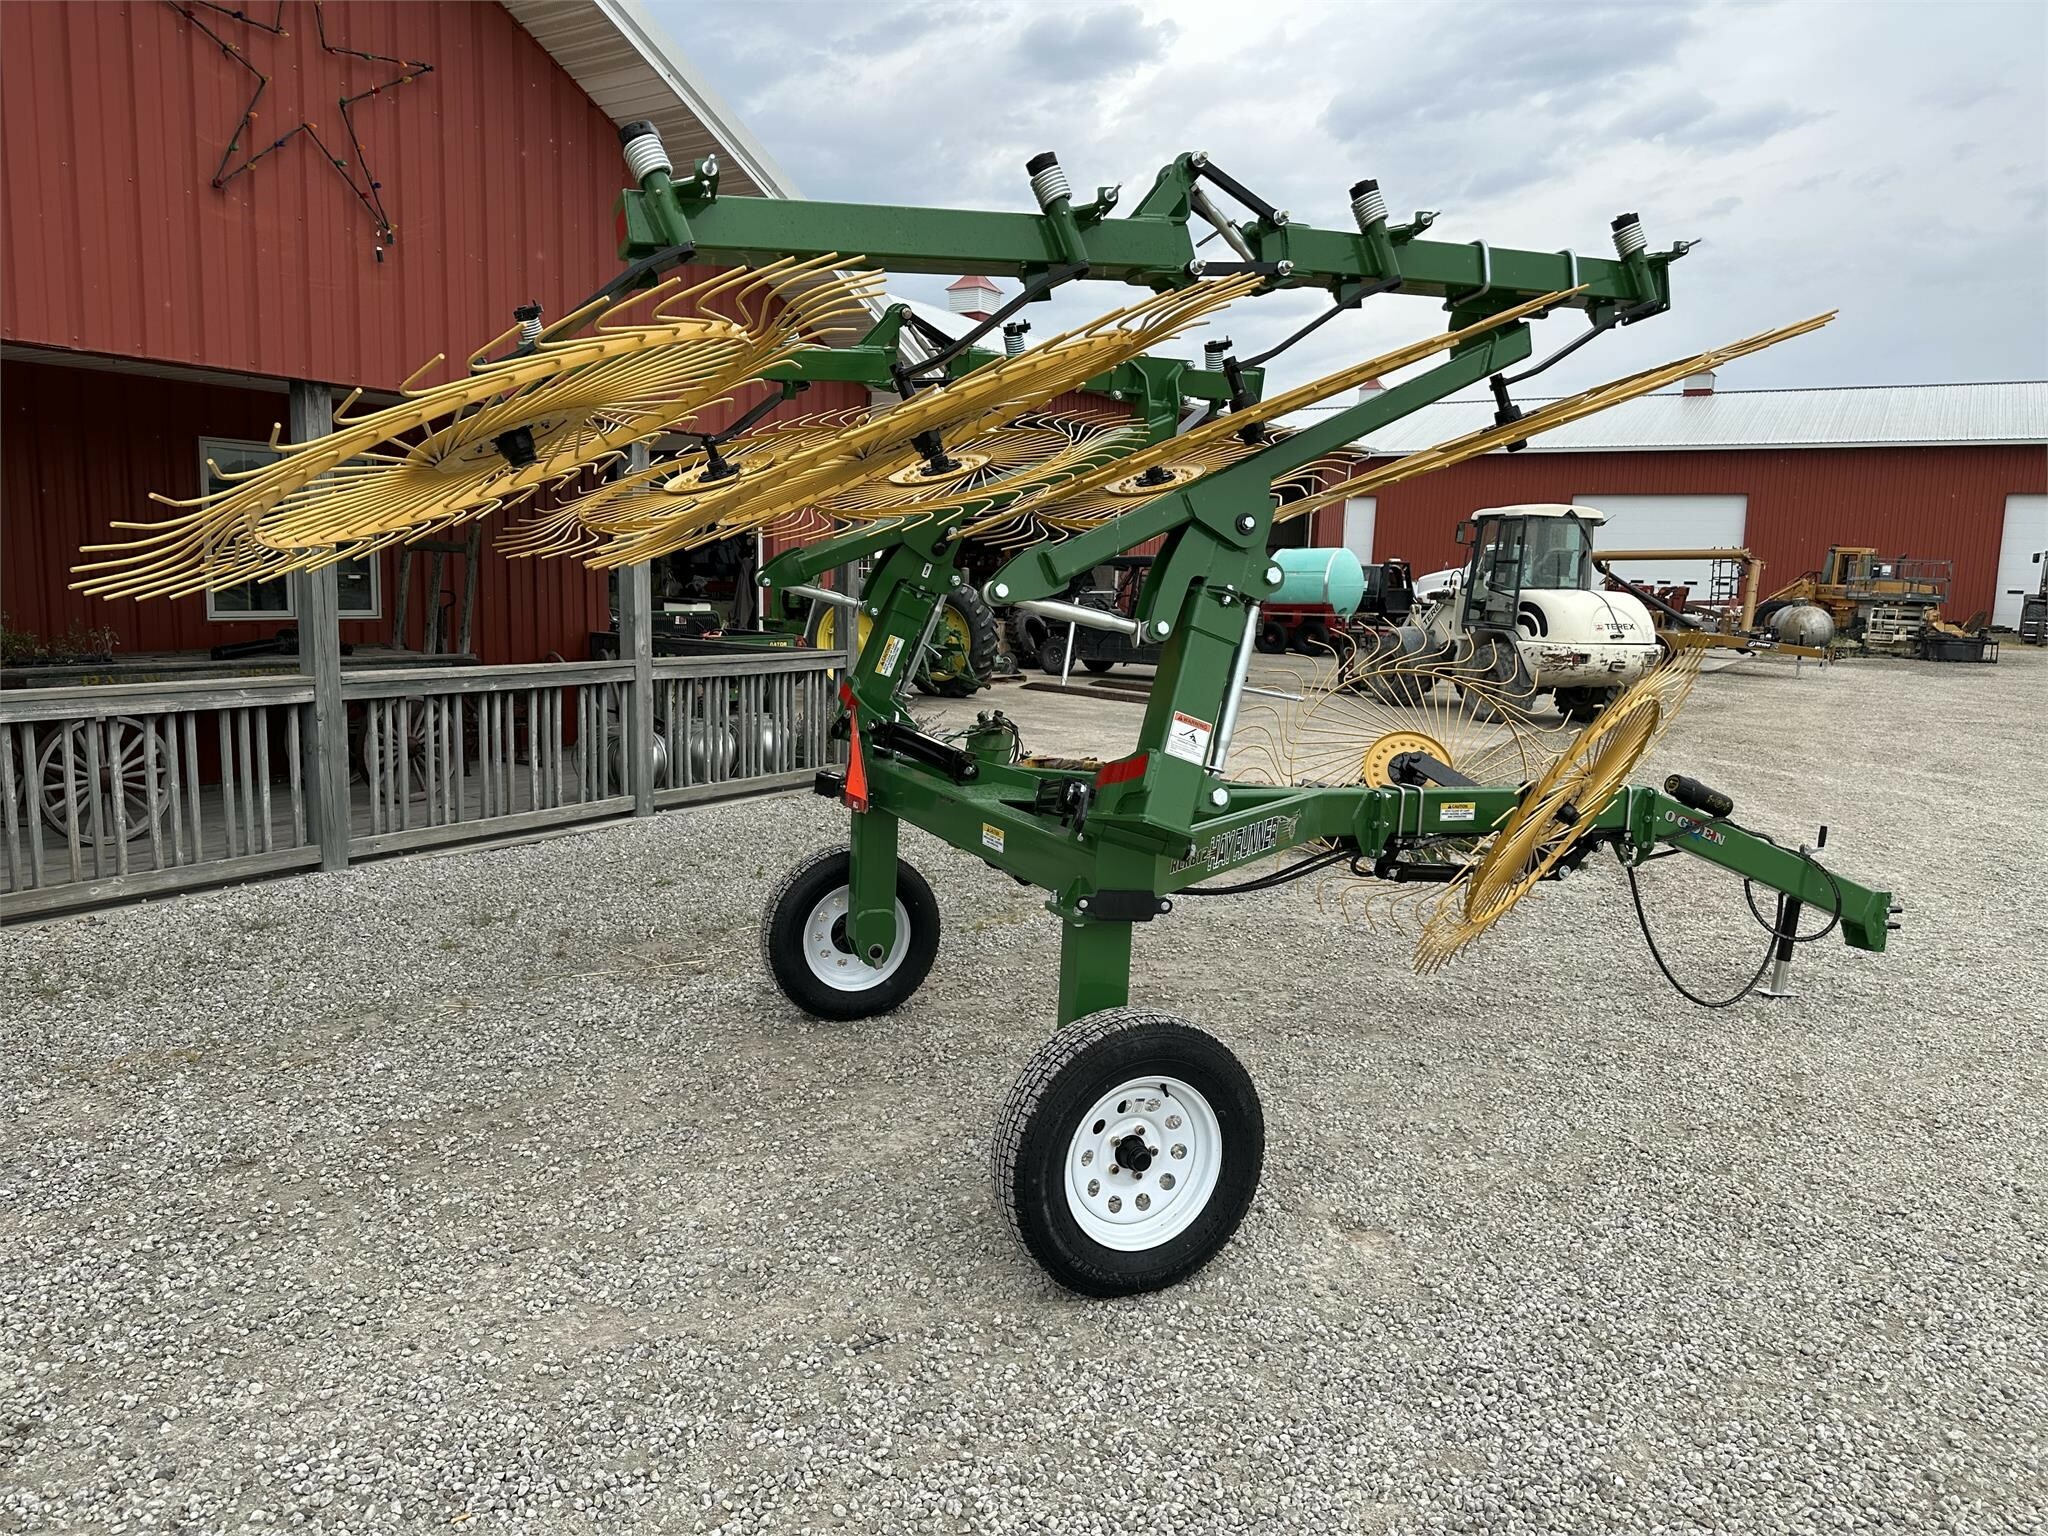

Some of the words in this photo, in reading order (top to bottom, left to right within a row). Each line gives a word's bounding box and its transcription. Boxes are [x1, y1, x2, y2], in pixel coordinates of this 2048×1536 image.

[1604, 623, 1636, 631] TEREX
[1232, 815, 1280, 862] RUNNER
[1664, 810, 1726, 846] OGDEN
